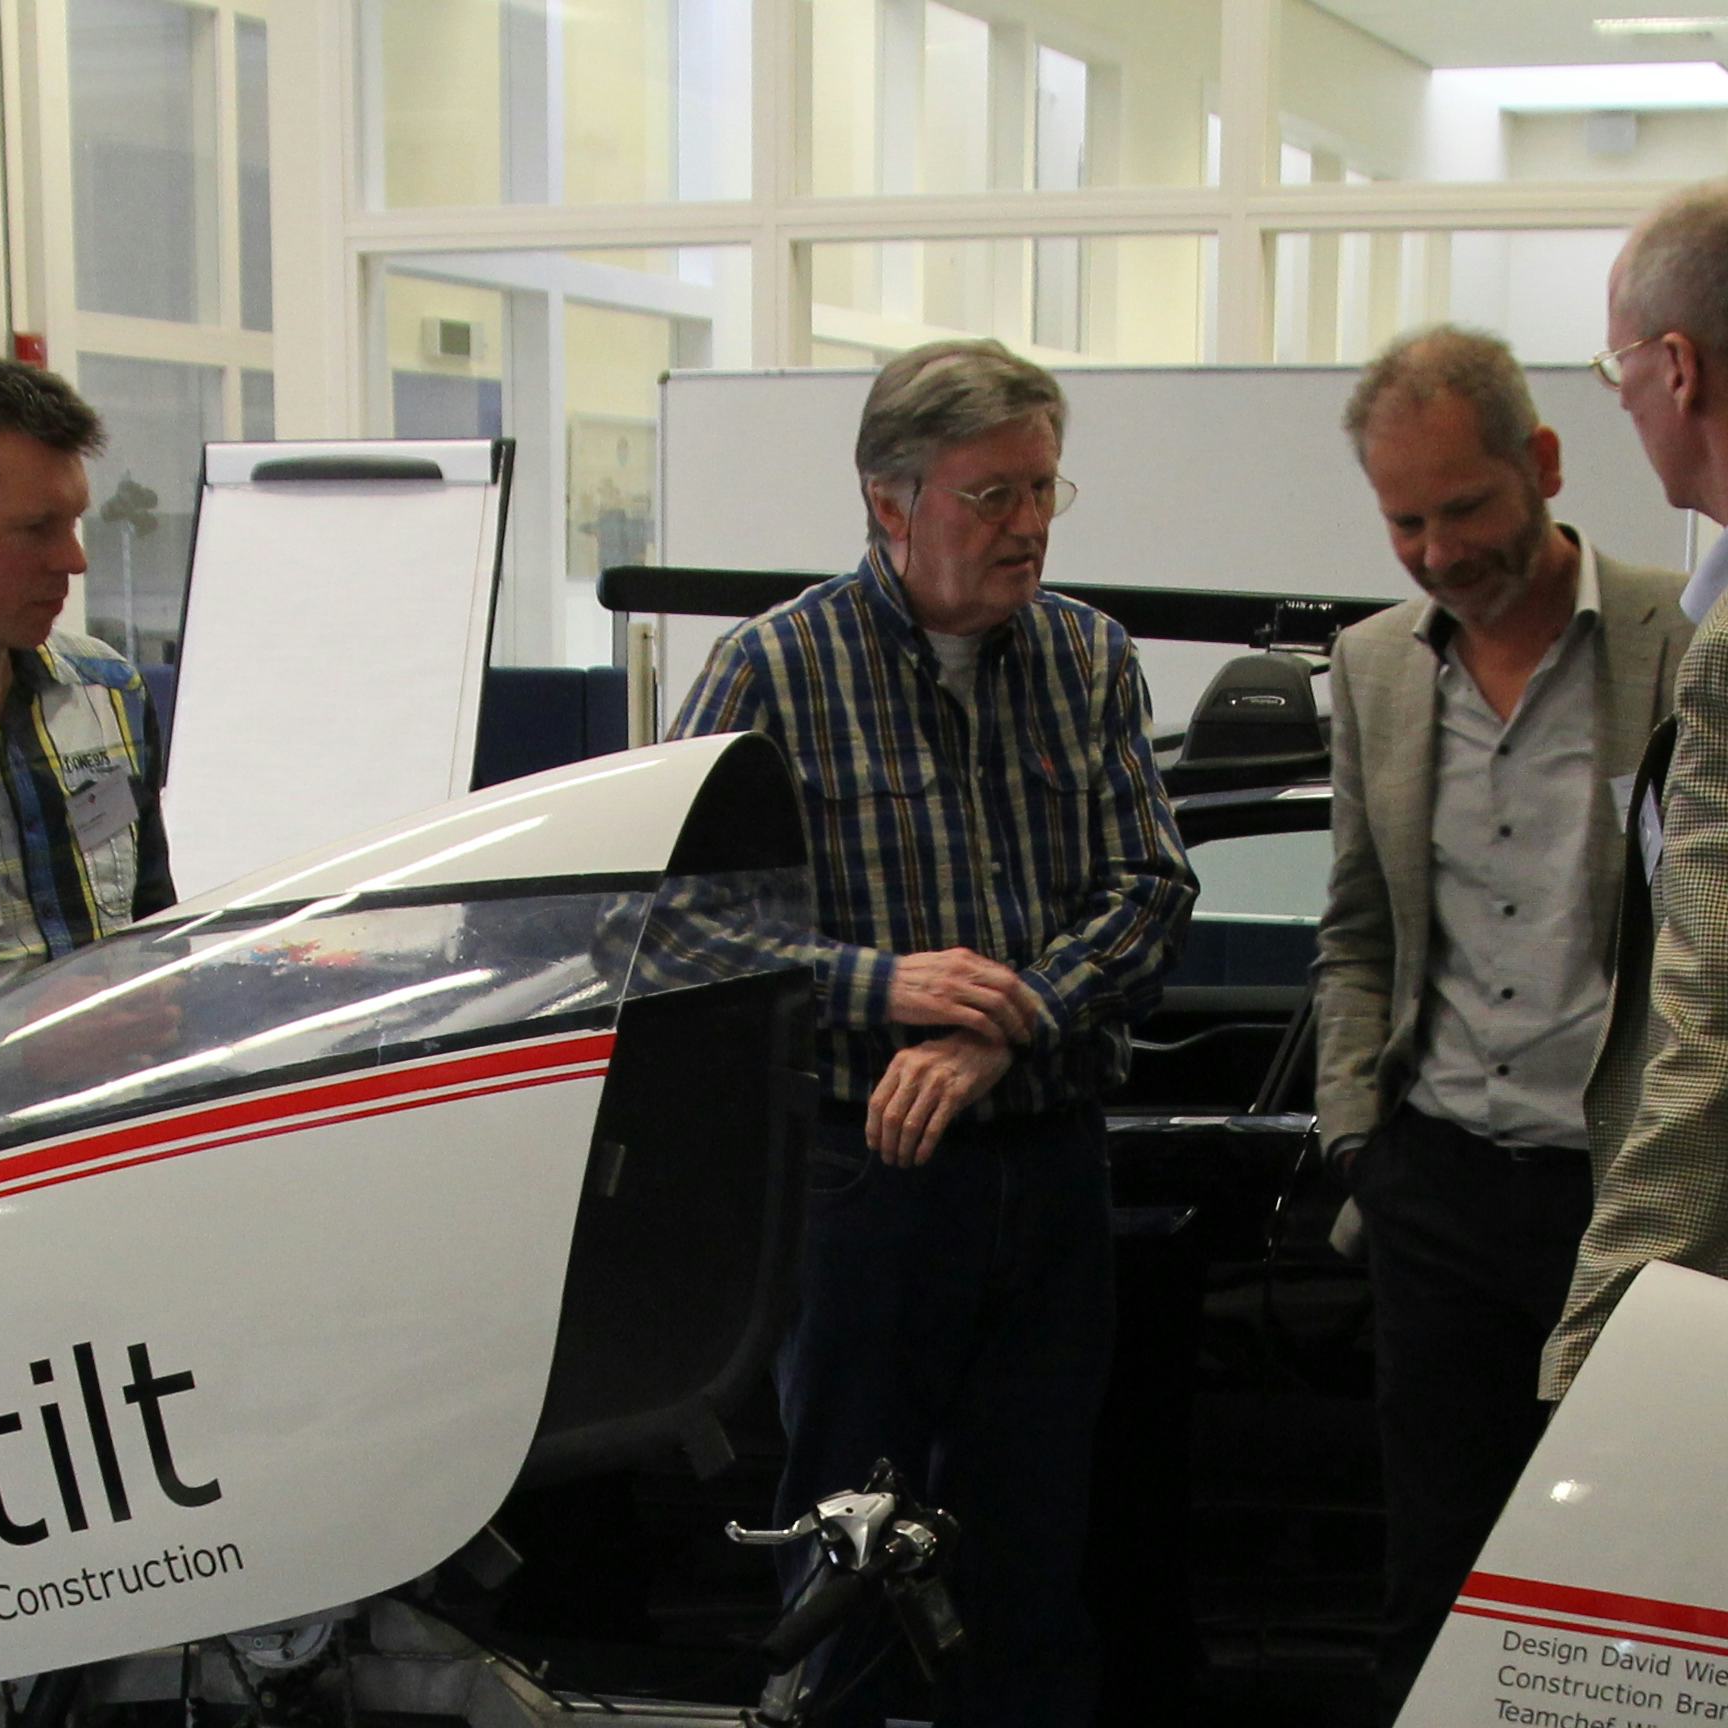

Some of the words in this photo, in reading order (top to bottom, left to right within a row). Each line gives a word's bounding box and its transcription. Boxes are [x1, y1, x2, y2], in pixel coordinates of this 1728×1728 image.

[1501, 1629, 1588, 1665] Design
[1601, 1645, 1671, 1677] David
[1497, 1665, 1663, 1710] Construction
